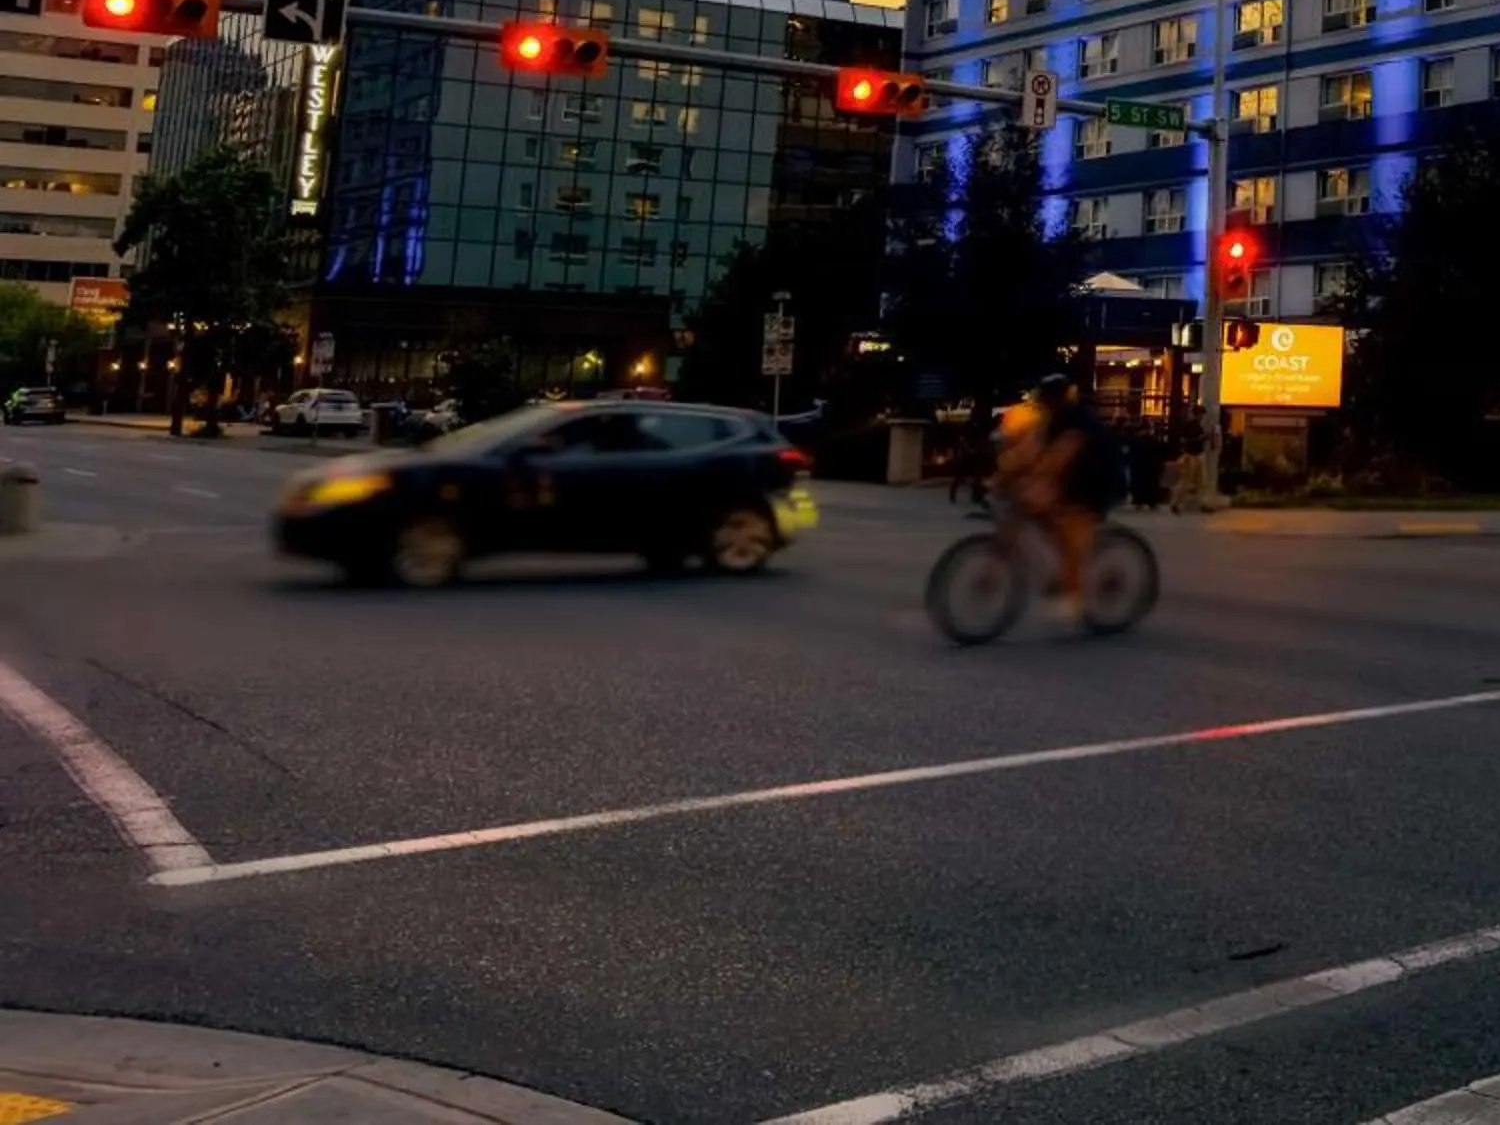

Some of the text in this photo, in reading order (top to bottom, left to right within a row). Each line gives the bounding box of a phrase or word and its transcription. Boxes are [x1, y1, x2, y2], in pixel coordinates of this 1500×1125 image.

[298, 45, 337, 199] WESTLEY
[1130, 106, 1150, 124] ST
[1157, 108, 1180, 127] SW
[1253, 355, 1310, 371] COAST
